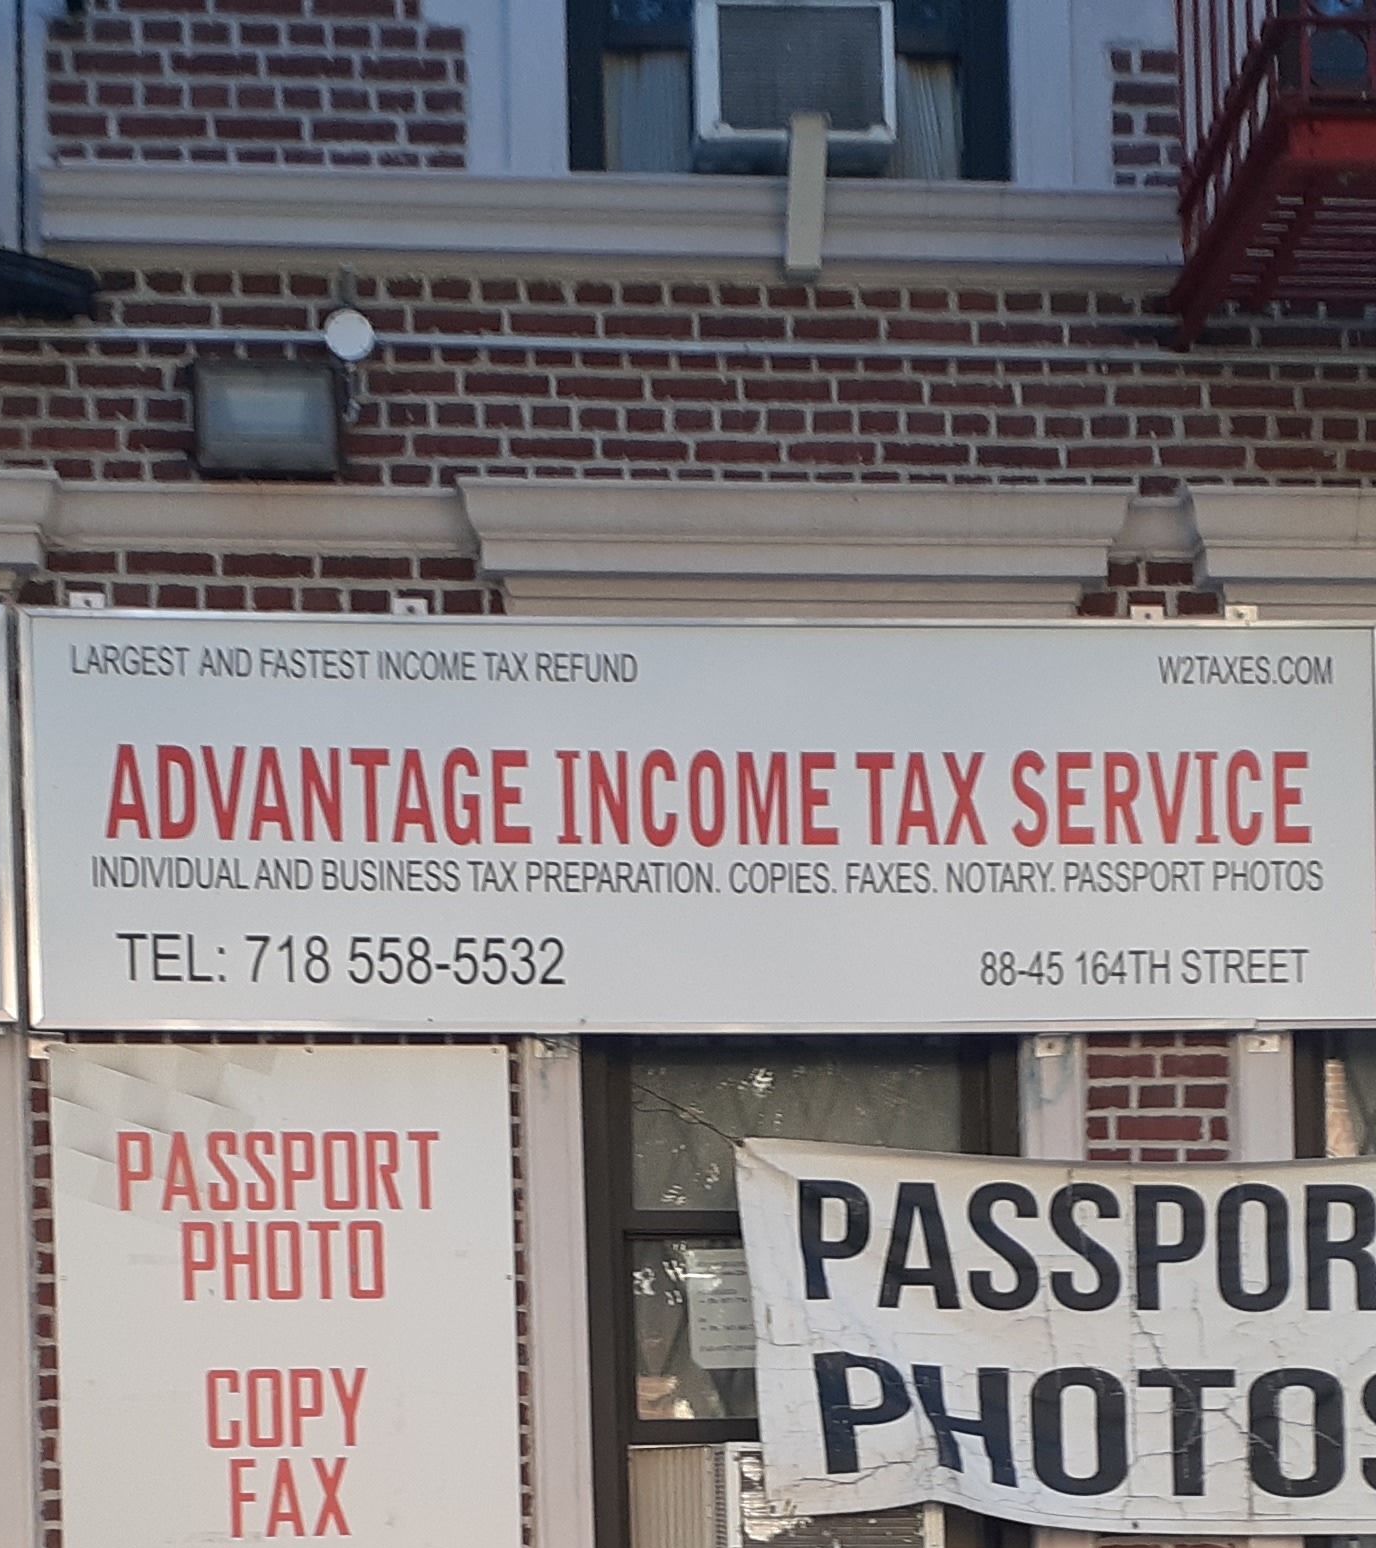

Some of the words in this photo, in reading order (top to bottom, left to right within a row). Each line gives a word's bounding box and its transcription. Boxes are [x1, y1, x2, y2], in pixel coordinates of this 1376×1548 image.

[72, 645, 189, 676] LARGEST
[200, 648, 252, 677] AND
[260, 648, 370, 679] FASTEST
[378, 651, 476, 680] INCOME
[482, 652, 528, 681] TAX
[536, 653, 637, 682] REFUND
[1158, 656, 1332, 685] W2TAXES.COM
[107, 744, 531, 845] ADVANTAGE
[556, 750, 838, 847] INCOME
[856, 752, 985, 845] TAX
[1012, 750, 1310, 847] SERVICE
[92, 856, 249, 889] INDIVIDUAL
[255, 859, 313, 890] AND
[322, 859, 460, 892] BUSINESS
[467, 861, 518, 892] TAX
[526, 861, 720, 893] PREPARATION.
[729, 862, 836, 894] COPIES.
[846, 862, 937, 893] FAXES.
[947, 862, 1055, 893] NOTARY.
[1064, 861, 1205, 892] PASSPORT
[1213, 860, 1323, 891] PHOTOS
[117, 933, 225, 982] TEL:
[246, 935, 329, 983] 718
[349, 937, 565, 985] 558-5532
[981, 951, 1063, 986] 88-45
[1076, 950, 1170, 985] 164TH
[1182, 949, 1309, 984] STREET
[117, 1130, 439, 1211] PASSPORT
[182, 1221, 384, 1300] PHOTO
[207, 1368, 366, 1448] COPY
[230, 1457, 349, 1538] FAX
